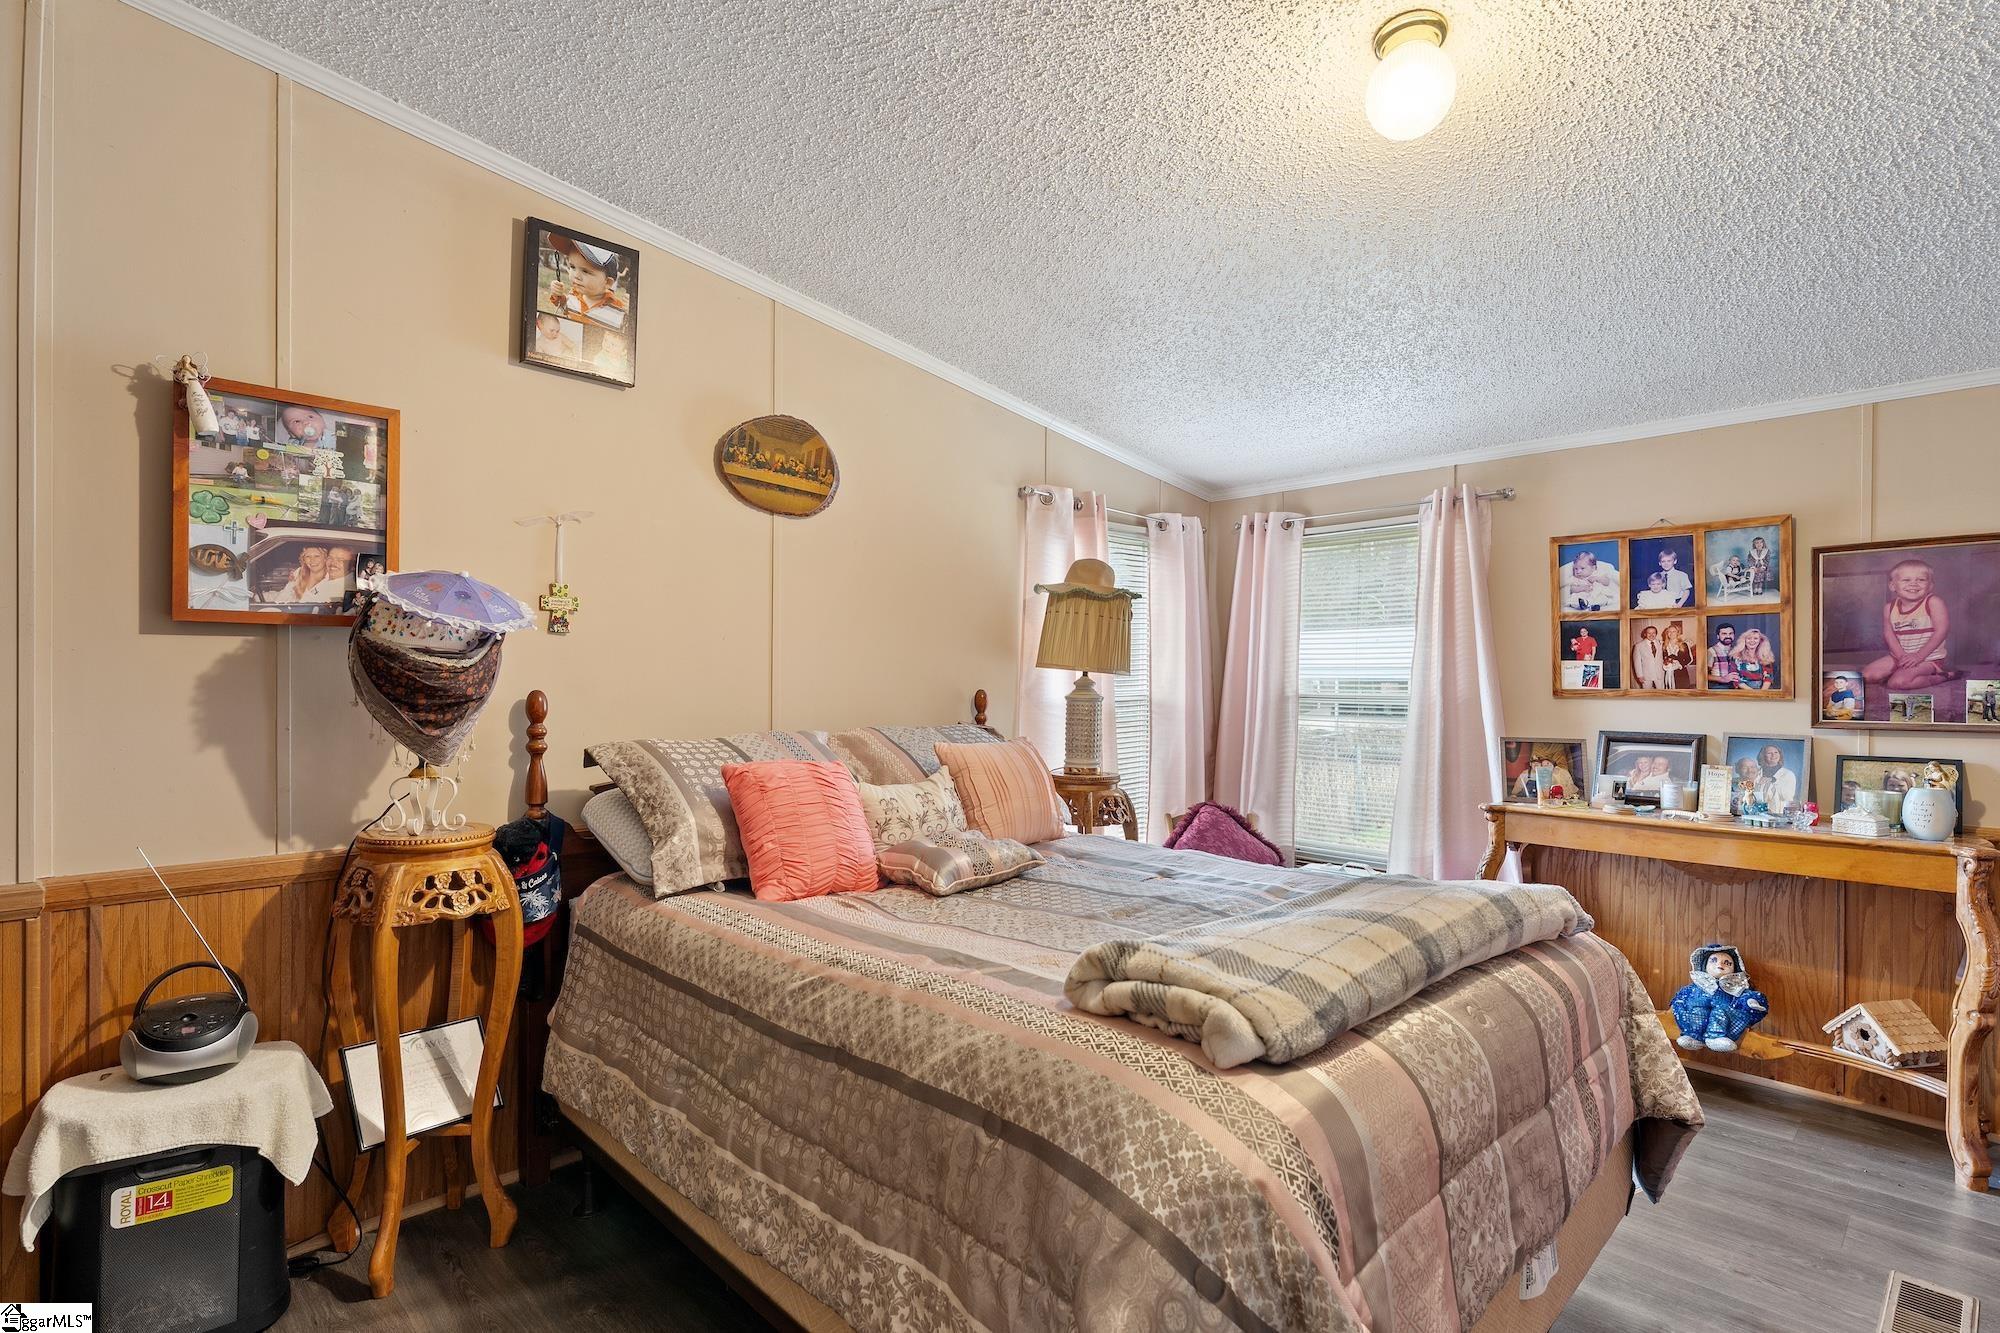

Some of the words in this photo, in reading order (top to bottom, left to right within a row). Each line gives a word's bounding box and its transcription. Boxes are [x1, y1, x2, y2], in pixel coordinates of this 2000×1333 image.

[195, 548, 233, 569] LOVE
[138, 1181, 173, 1195] Crosscut
[173, 1175, 197, 1189] Paper
[196, 1169, 229, 1183] Shredder
[120, 1190, 132, 1225] ROYAL
[147, 1192, 170, 1210] 14
